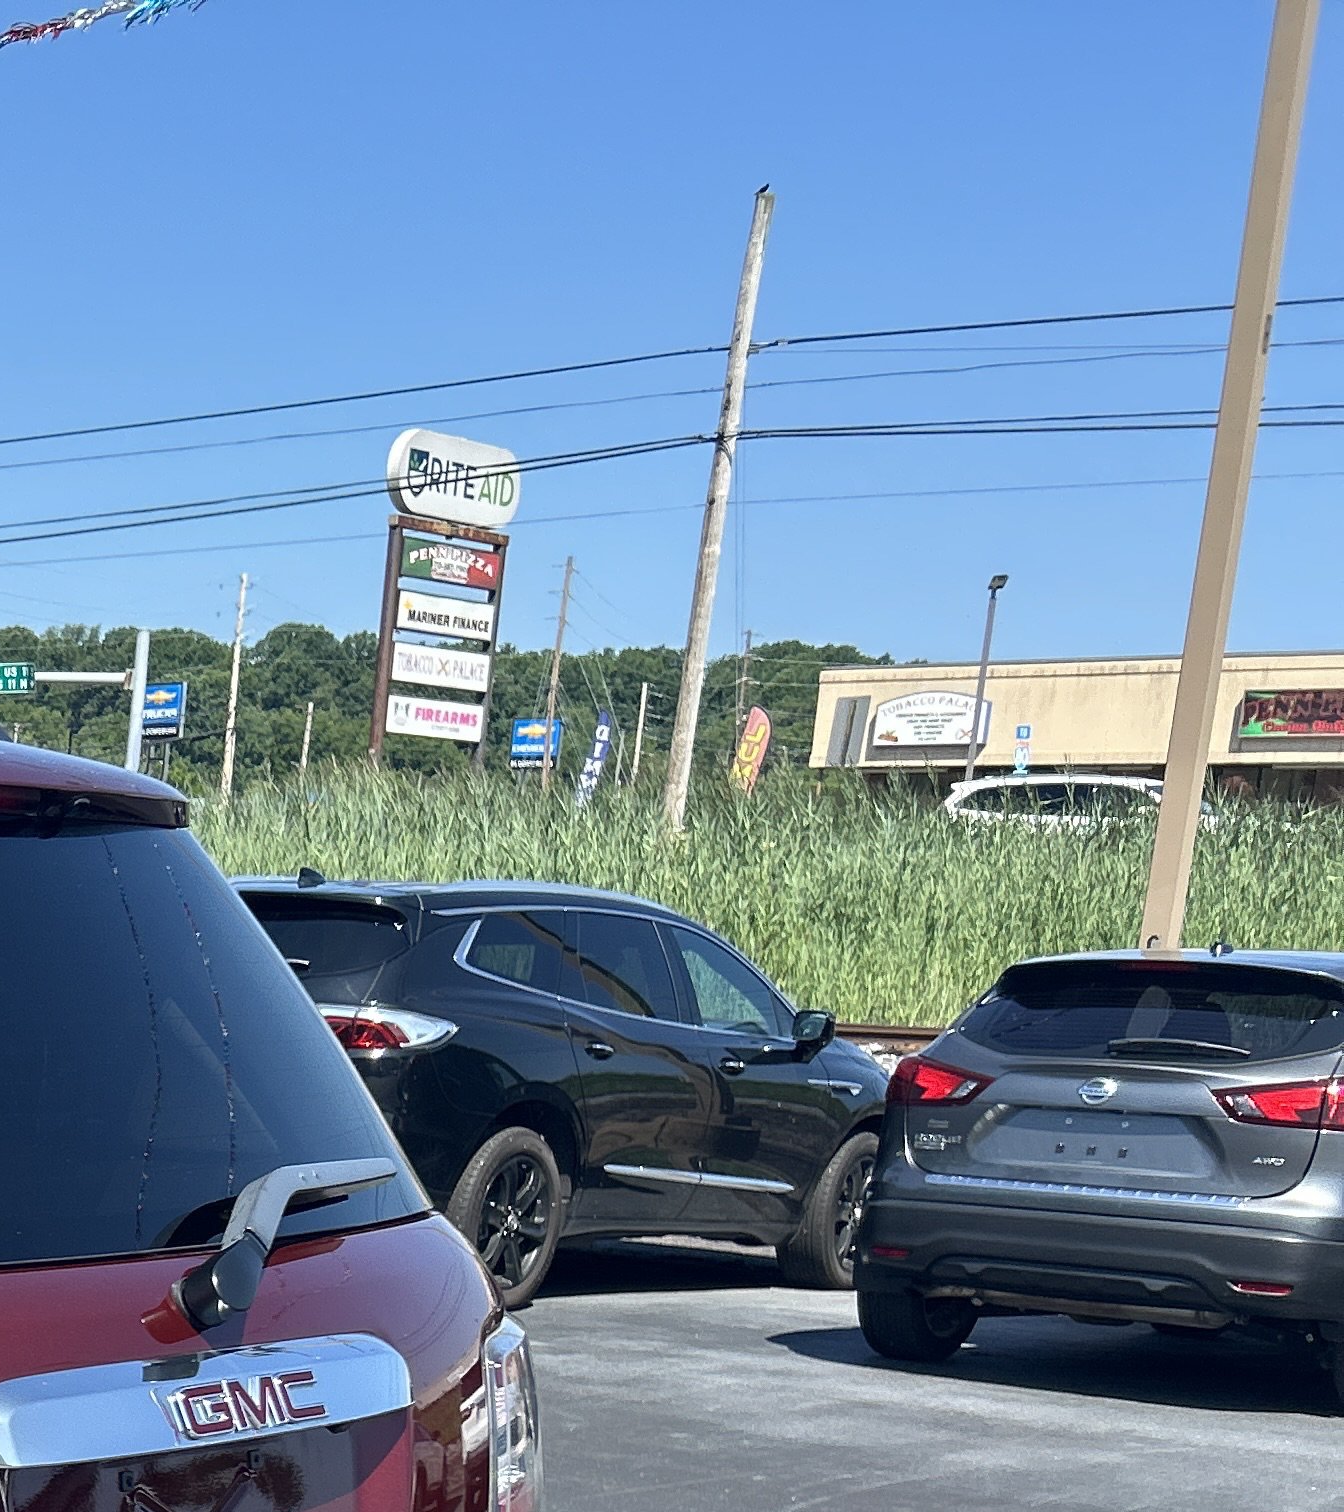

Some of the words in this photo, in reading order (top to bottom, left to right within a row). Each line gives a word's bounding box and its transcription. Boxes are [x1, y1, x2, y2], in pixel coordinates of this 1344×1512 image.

[429, 457, 477, 499] RITE
[478, 471, 514, 507] AID
[409, 546, 448, 564] PENN
[451, 548, 493, 578] PIZZA
[407, 609, 451, 628] MARINER
[452, 615, 490, 634] FINANCE
[3, 666, 18, 678] US
[397, 652, 433, 675] TOBACCO
[452, 659, 486, 682] PALACE
[414, 706, 479, 728] FIREARMS
[880, 696, 936, 718] TOBACCO
[169, 1368, 330, 1440] GMC
